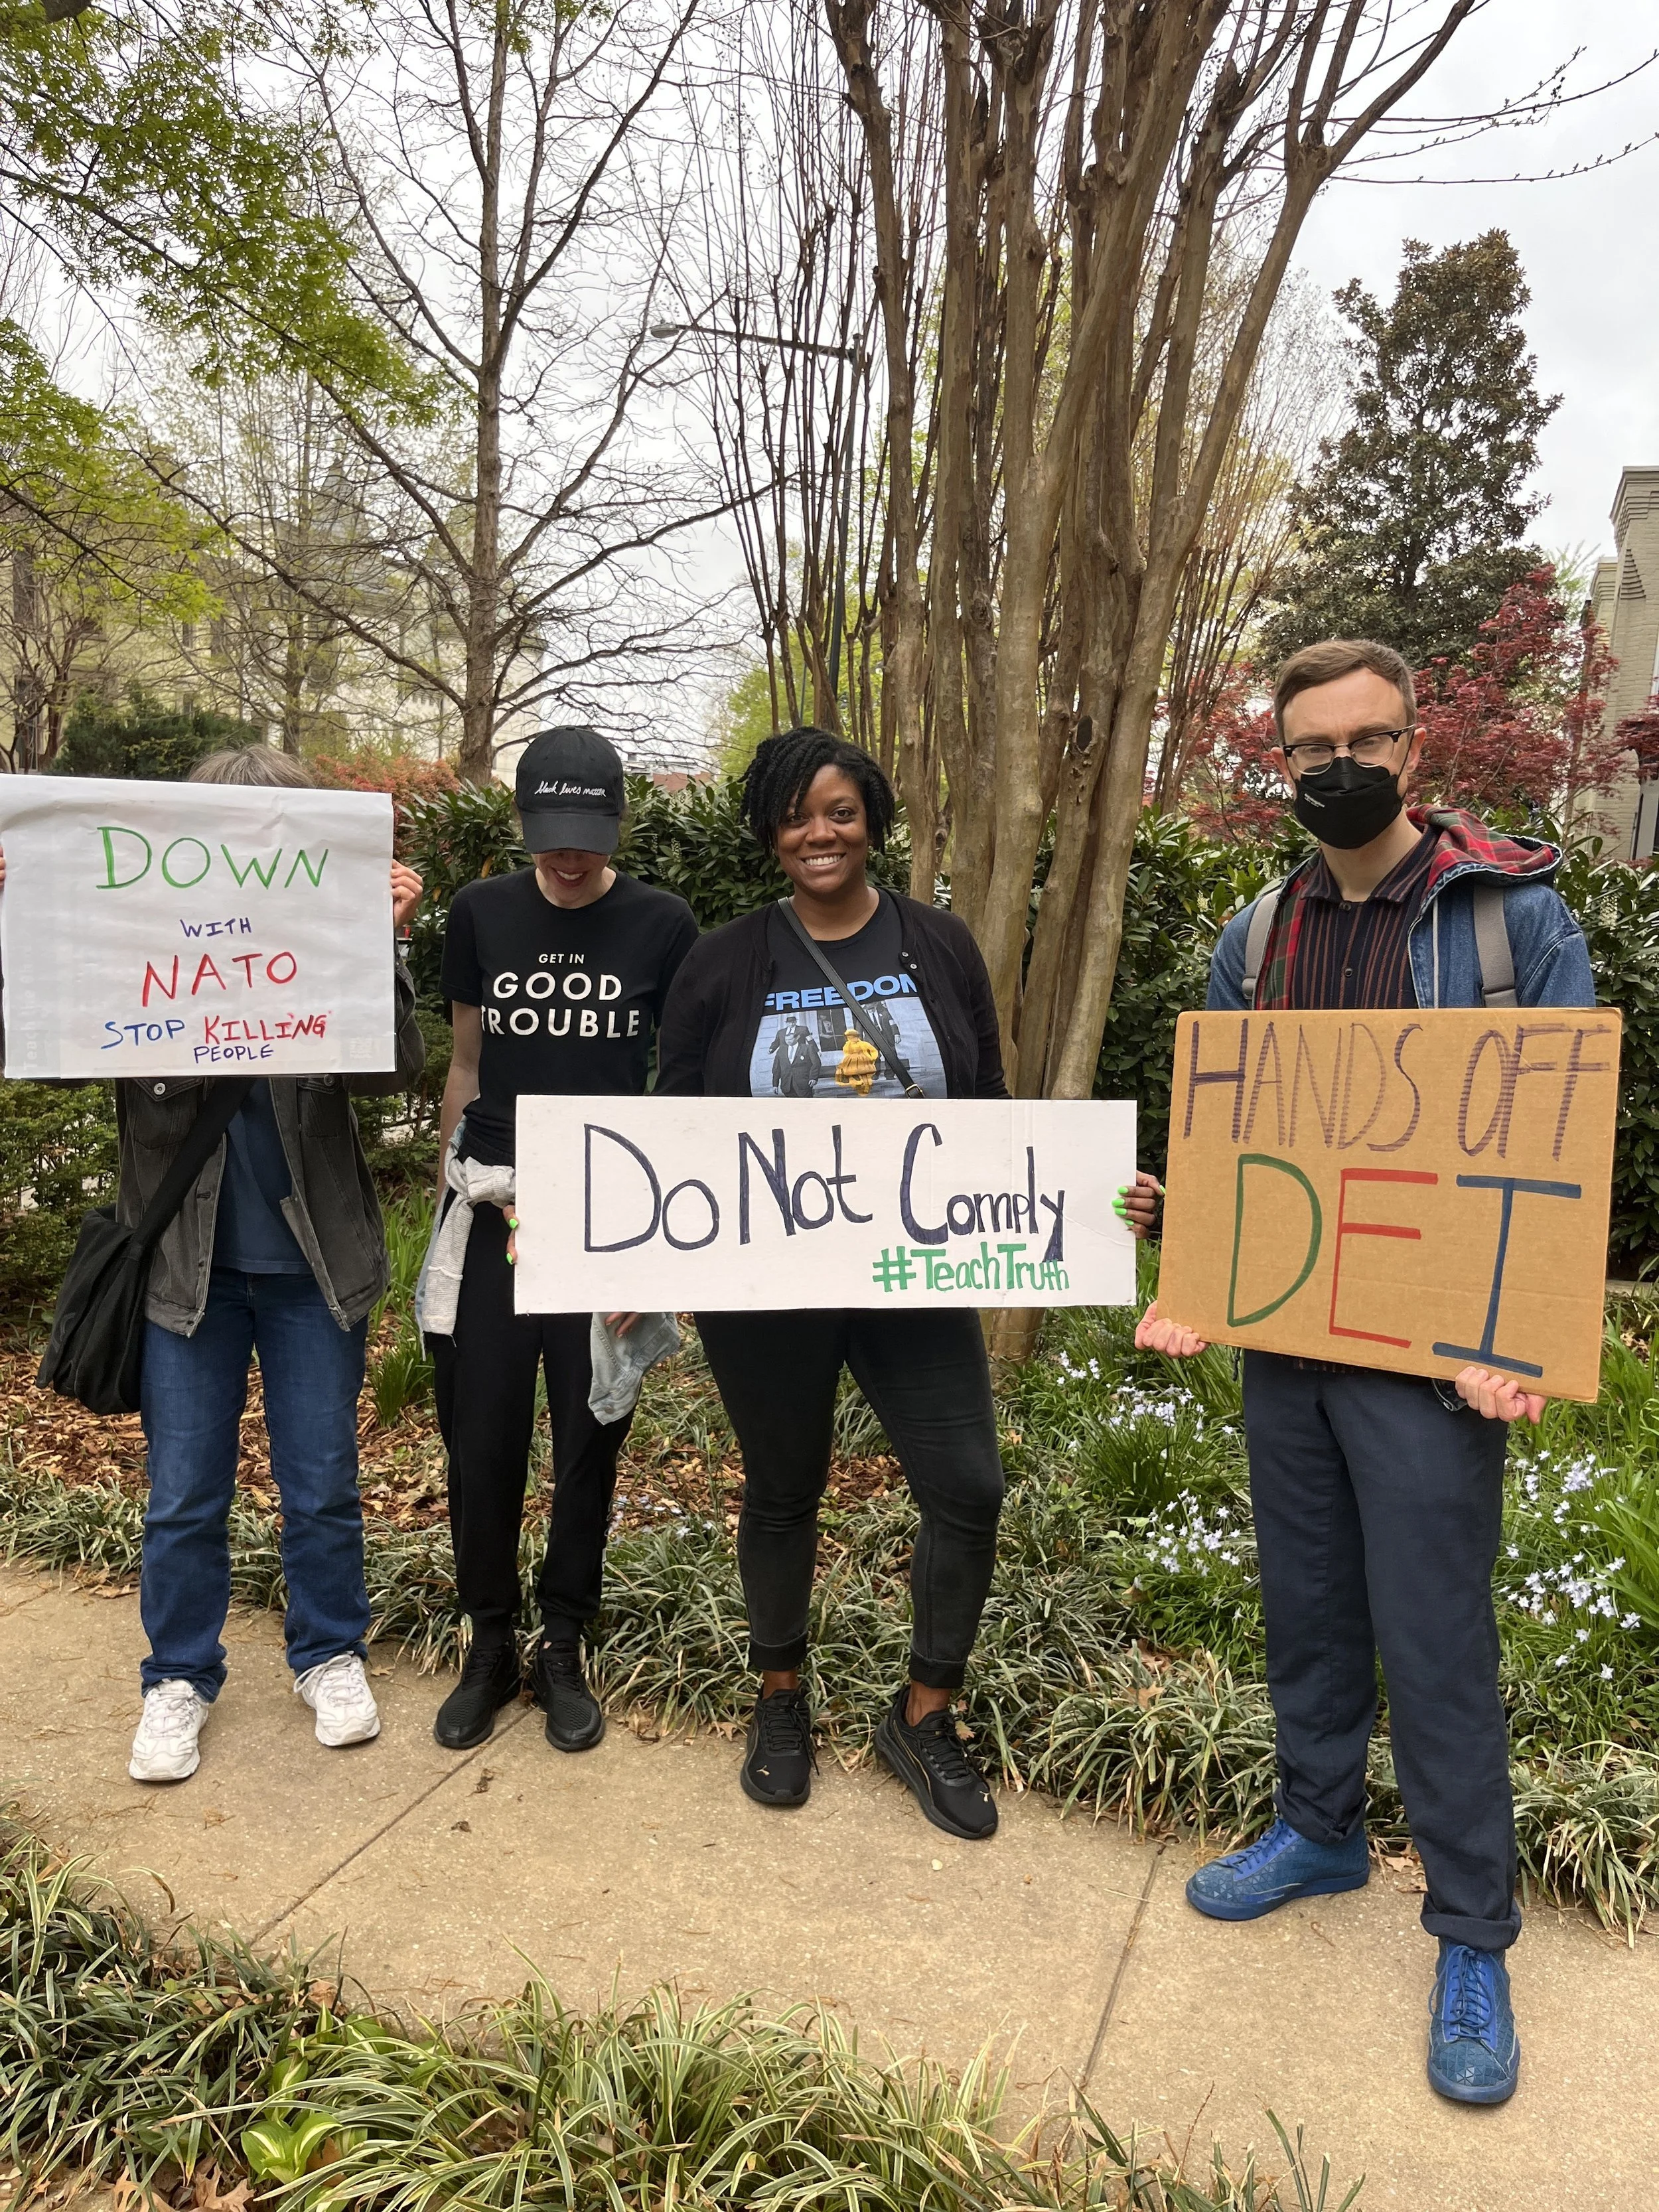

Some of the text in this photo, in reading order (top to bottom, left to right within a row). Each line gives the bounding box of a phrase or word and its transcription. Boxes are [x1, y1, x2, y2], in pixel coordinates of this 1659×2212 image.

[534, 780, 558, 796] black
[558, 782, 581, 796] lives
[96, 826, 329, 889] DOWN
[179, 917, 252, 938] WITH
[142, 951, 297, 1007] NATO
[538, 953, 585, 964] GET IN
[493, 972, 622, 1001] GOOD
[101, 1014, 326, 1049] STOP KILLING
[194, 1044, 274, 1063] PEOPLE
[1183, 1018, 1612, 1161] HANDS OFF
[584, 1123, 1065, 1262] Do Not Comply
[872, 1240, 1070, 1292] #TeachTruth
[1226, 1153, 1582, 1378] DEI
